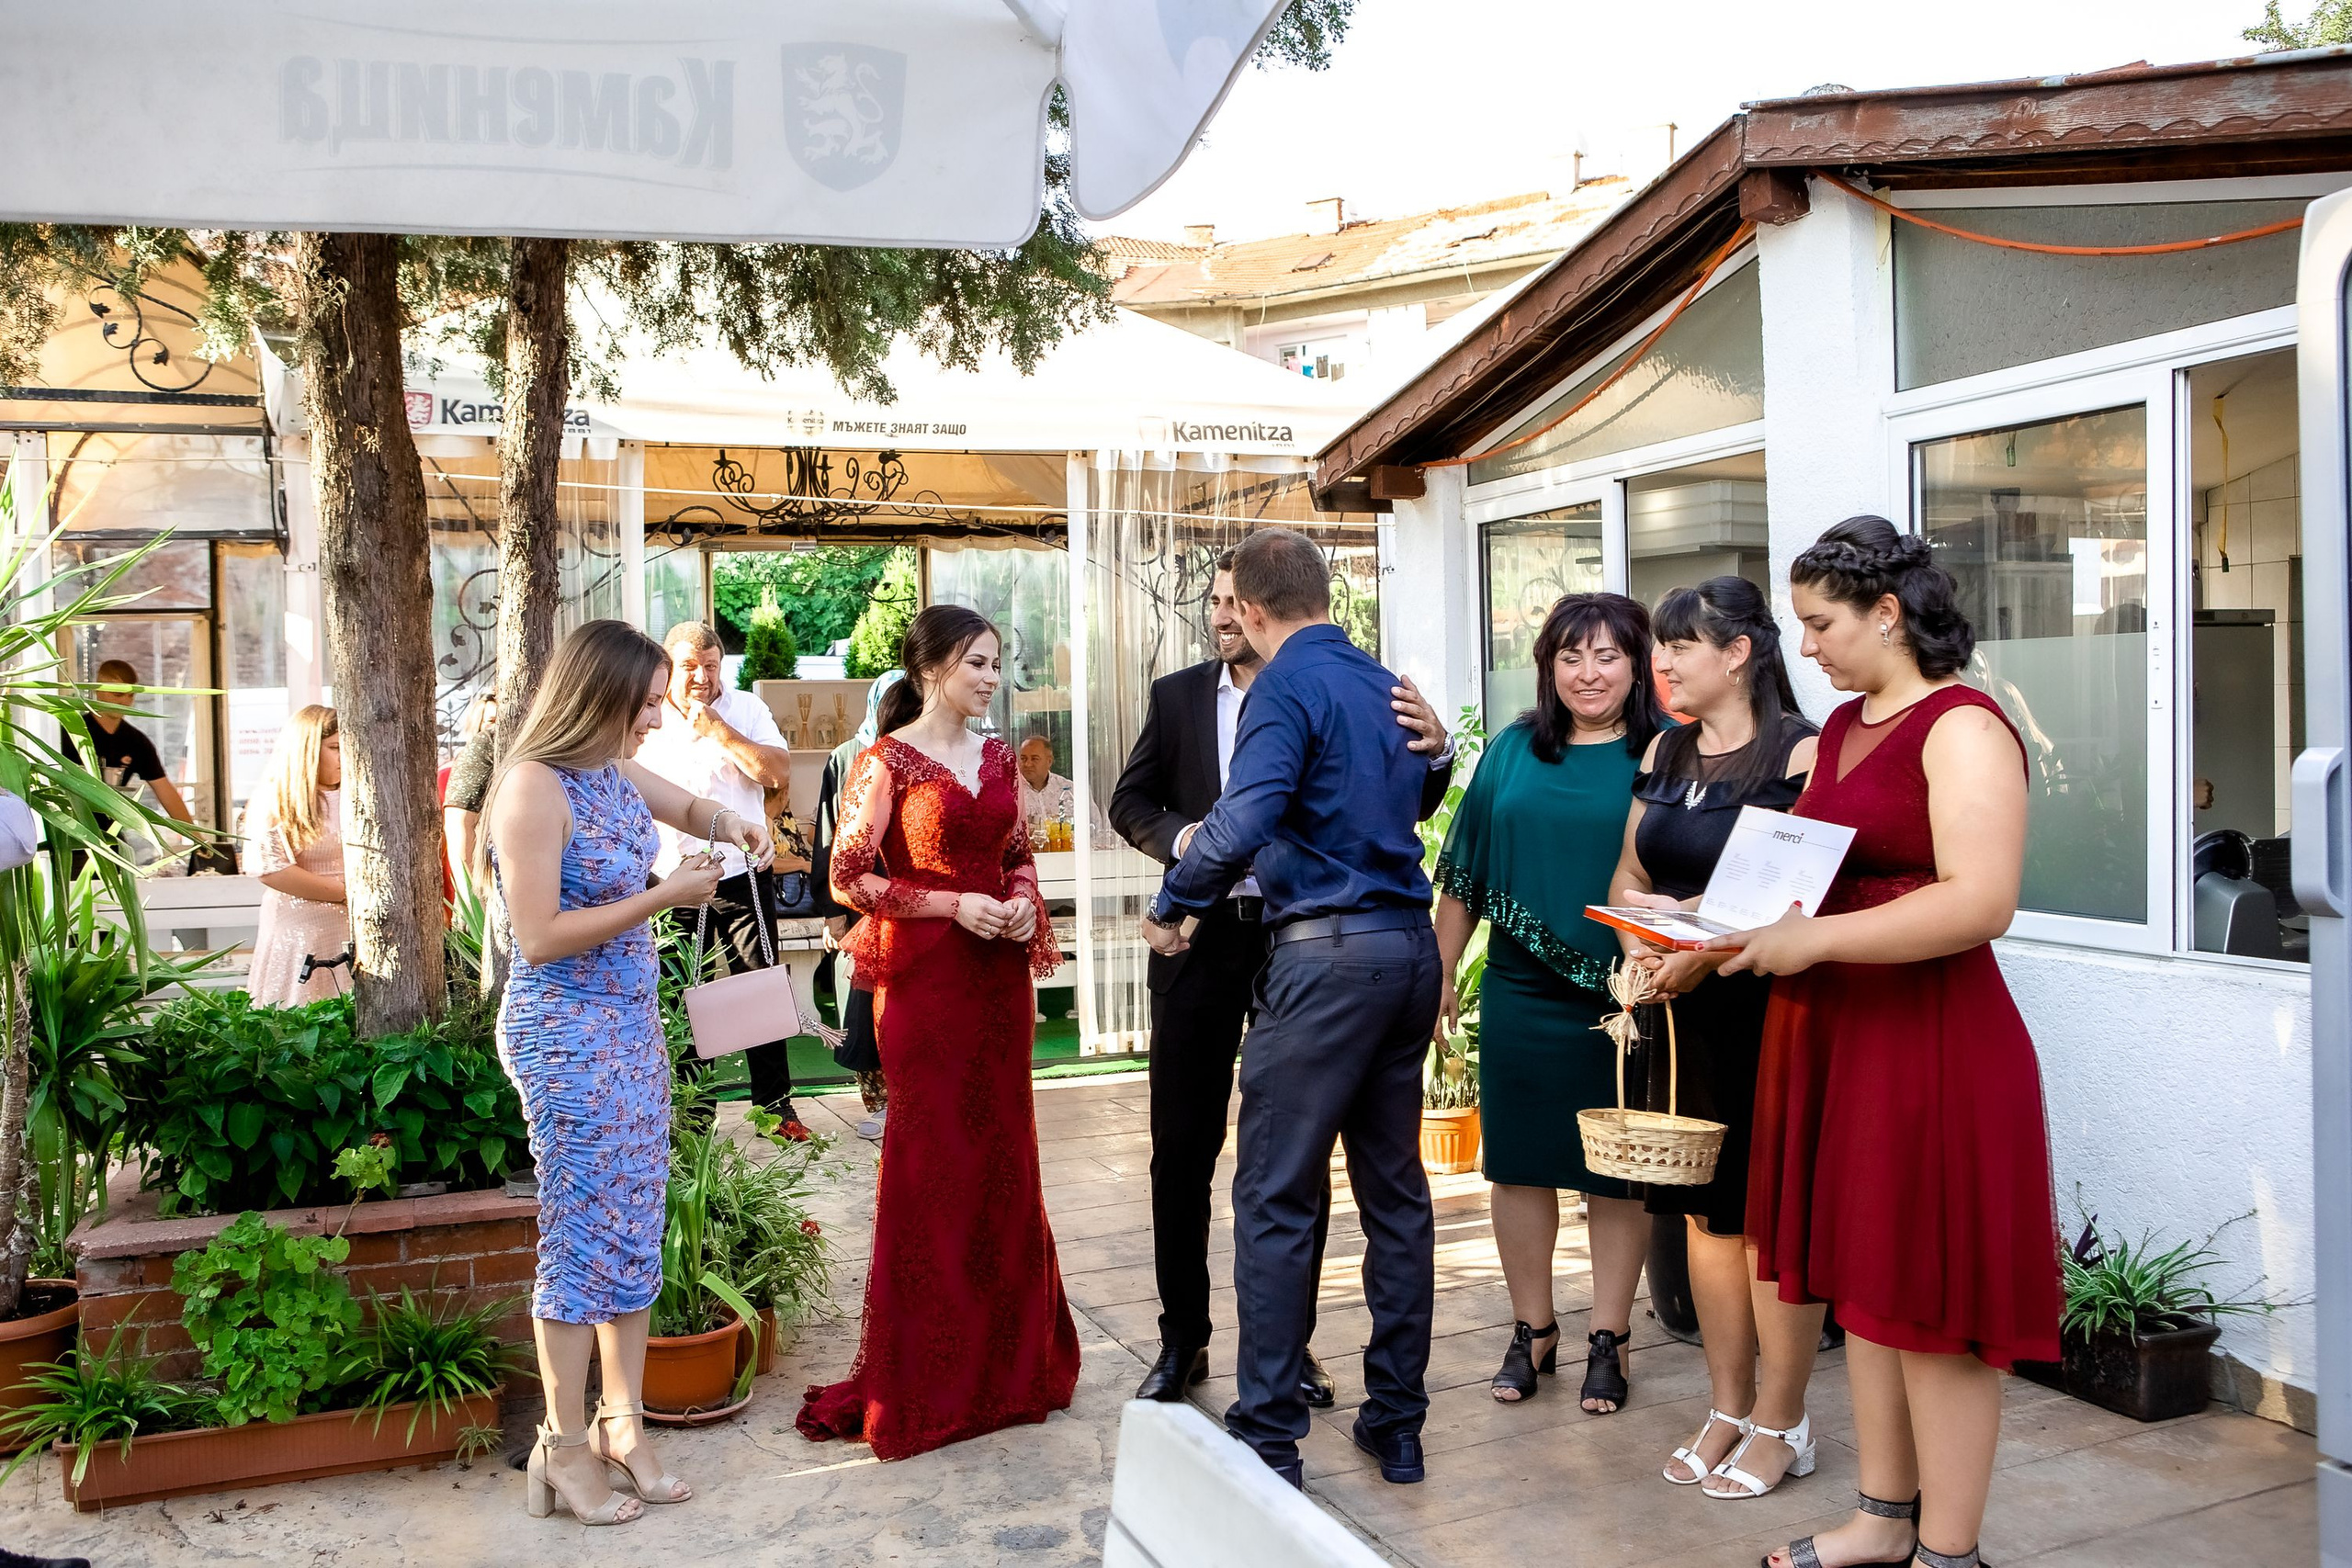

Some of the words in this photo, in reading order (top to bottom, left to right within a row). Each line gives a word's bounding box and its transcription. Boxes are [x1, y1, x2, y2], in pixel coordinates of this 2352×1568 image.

[441, 399, 590, 426] Kamza
[832, 421, 887, 433] МЪЖЕТЕ
[890, 423, 929, 434] ЗНАЯТ
[932, 423, 967, 435] ЗАЩО
[1172, 421, 1293, 443] Kamenitza
[1773, 830, 1804, 844] merci
